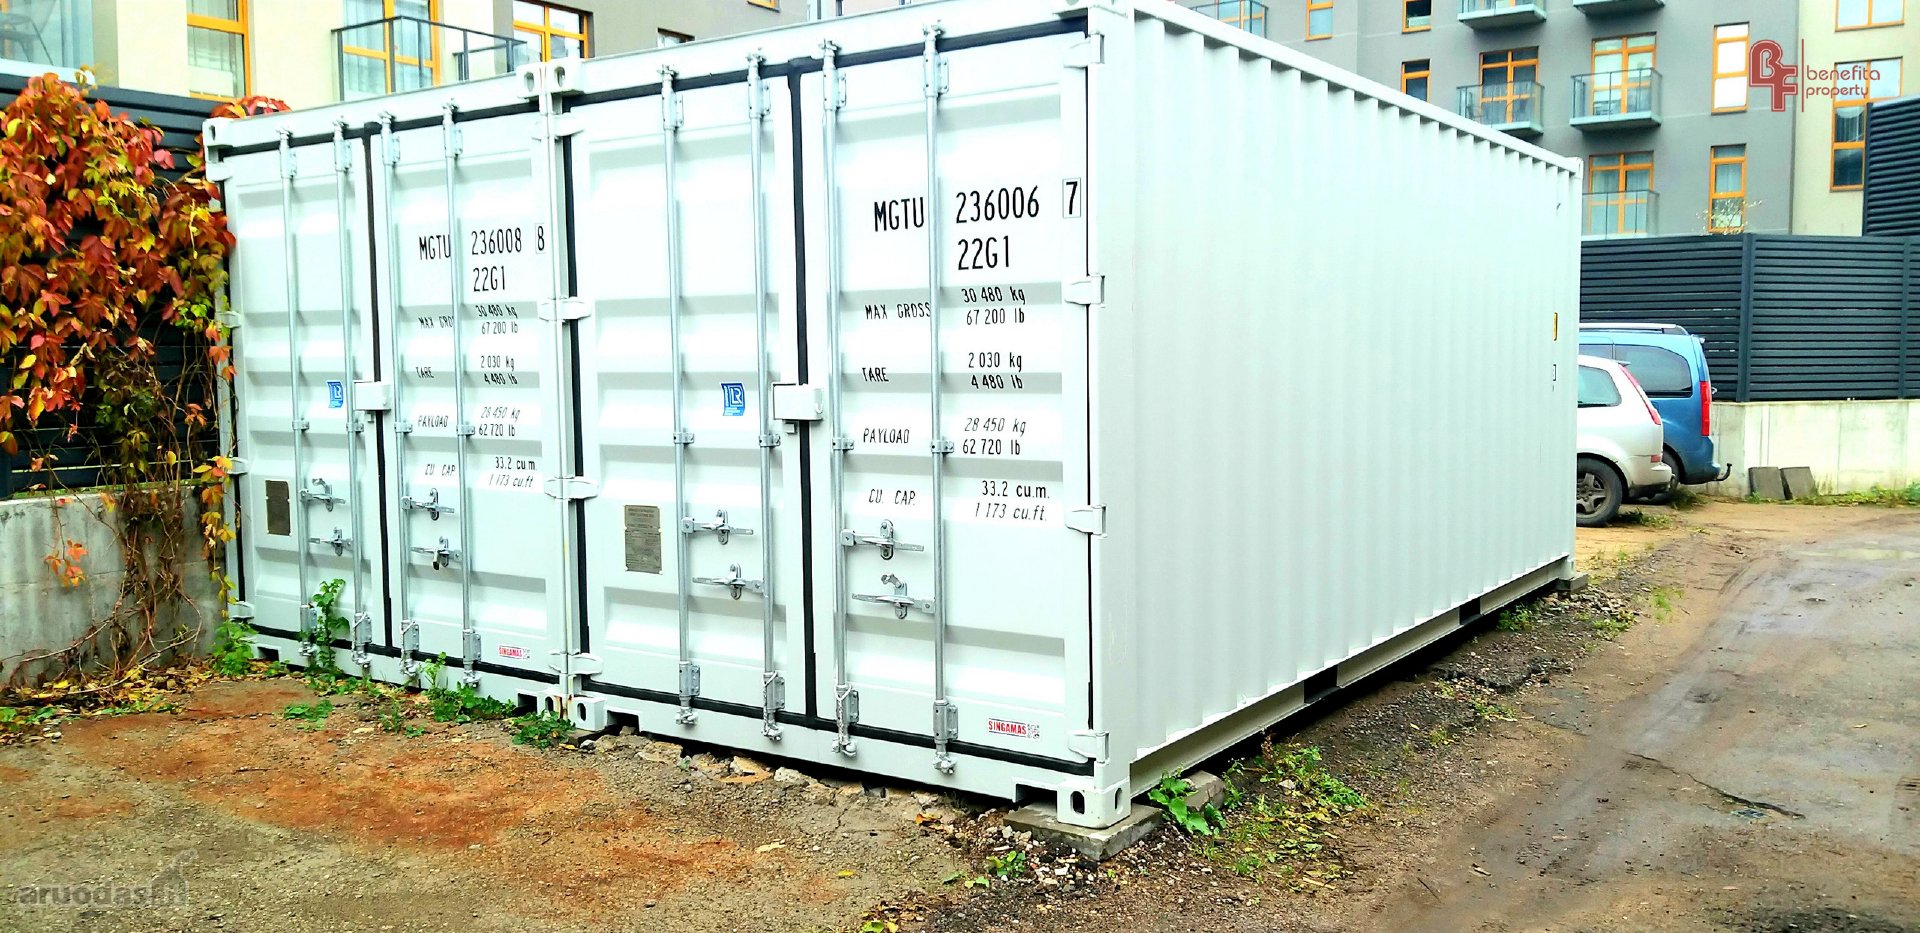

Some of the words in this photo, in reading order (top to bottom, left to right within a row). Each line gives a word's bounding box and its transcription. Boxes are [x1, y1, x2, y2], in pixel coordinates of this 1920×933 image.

[873, 197, 924, 232] MGTU
[956, 185, 1040, 224] 236006
[1065, 180, 1079, 215] 7
[419, 234, 451, 260] MGTU
[471, 227, 522, 255] 236008
[537, 225, 545, 251] 8
[957, 235, 1010, 270] 22G1
[473, 265, 506, 292] 22G1
[961, 287, 978, 303] 30
[980, 286, 1003, 302] 480
[1009, 285, 1026, 305] kg
[505, 304, 518, 319] kg
[865, 303, 889, 320] MAX
[896, 302, 931, 319] GROSS
[966, 310, 979, 325] 67
[984, 309, 1006, 325] 200
[418, 316, 434, 329] MAX
[505, 355, 515, 371] kg
[968, 352, 974, 368] 2
[979, 352, 1001, 368] 030
[1009, 352, 1022, 372] kg
[416, 366, 435, 379] TARE
[862, 367, 889, 382] TARE
[971, 374, 979, 389] 4
[982, 374, 1004, 389] 480
[418, 415, 449, 428] PAYLOAD
[510, 408, 521, 422] kg
[983, 417, 1005, 432] 450
[1012, 418, 1026, 436] kg
[863, 428, 910, 444] PAYLOAD
[963, 439, 977, 454] 62
[981, 439, 1002, 455] 720
[495, 456, 512, 470] 33.2
[982, 480, 1009, 497] 33.2
[986, 503, 1007, 519] 173
[988, 720, 1027, 735] SINGAMAS
